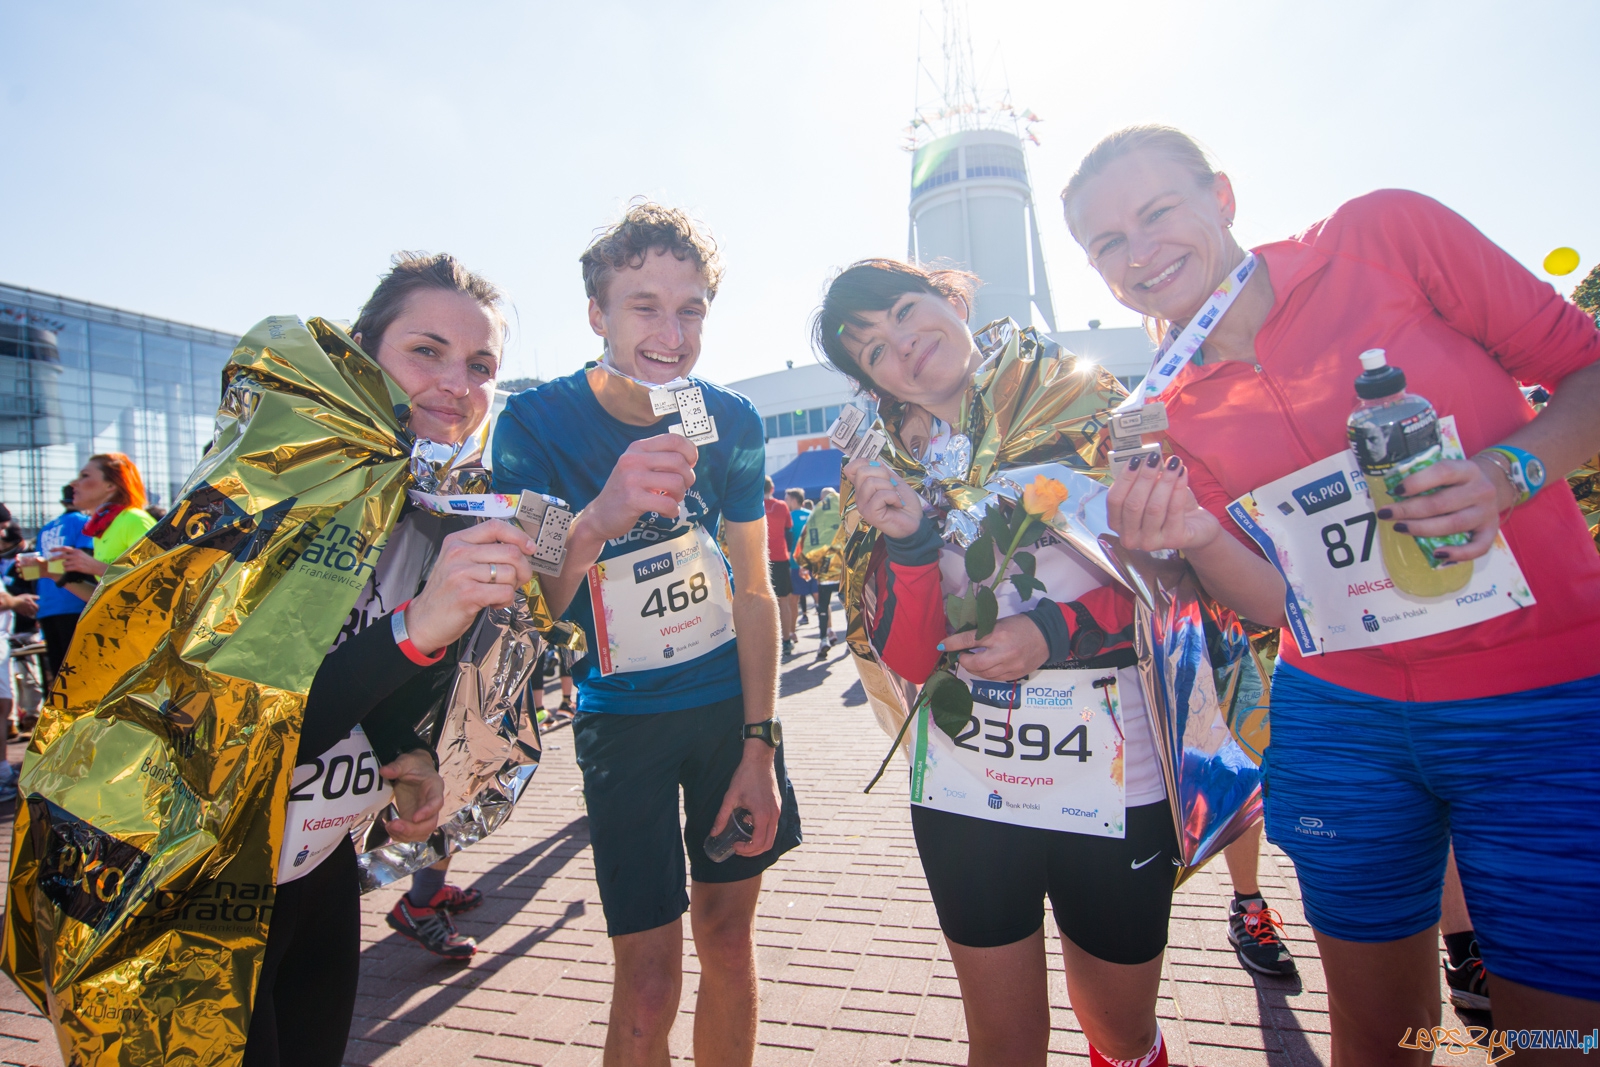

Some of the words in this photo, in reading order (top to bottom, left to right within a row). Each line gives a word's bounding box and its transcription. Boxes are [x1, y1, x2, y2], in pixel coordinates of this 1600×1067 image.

[693, 407, 702, 415] 25
[1301, 491, 1321, 506] 16.
[1320, 481, 1345, 499] PKO
[553, 532, 562, 541] 25
[1034, 535, 1061, 549] TEA
[1321, 511, 1377, 569] 87
[637, 567, 651, 577] 16.
[650, 558, 671, 573] PKO
[640, 571, 709, 618] 468
[1381, 614, 1401, 624] Bank
[1402, 607, 1428, 618] Polski
[660, 616, 702, 637] Wojciech
[988, 689, 1017, 702] PKO
[1026, 697, 1073, 706] maraton
[954, 715, 1093, 763] 2394
[140, 756, 170, 784] Bank
[985, 768, 1054, 788] Katarzyna
[1005, 801, 1022, 810] Bank
[1022, 803, 1041, 811] Polski
[302, 813, 360, 832] Katarzyna
[1294, 826, 1337, 839] Kalenji
